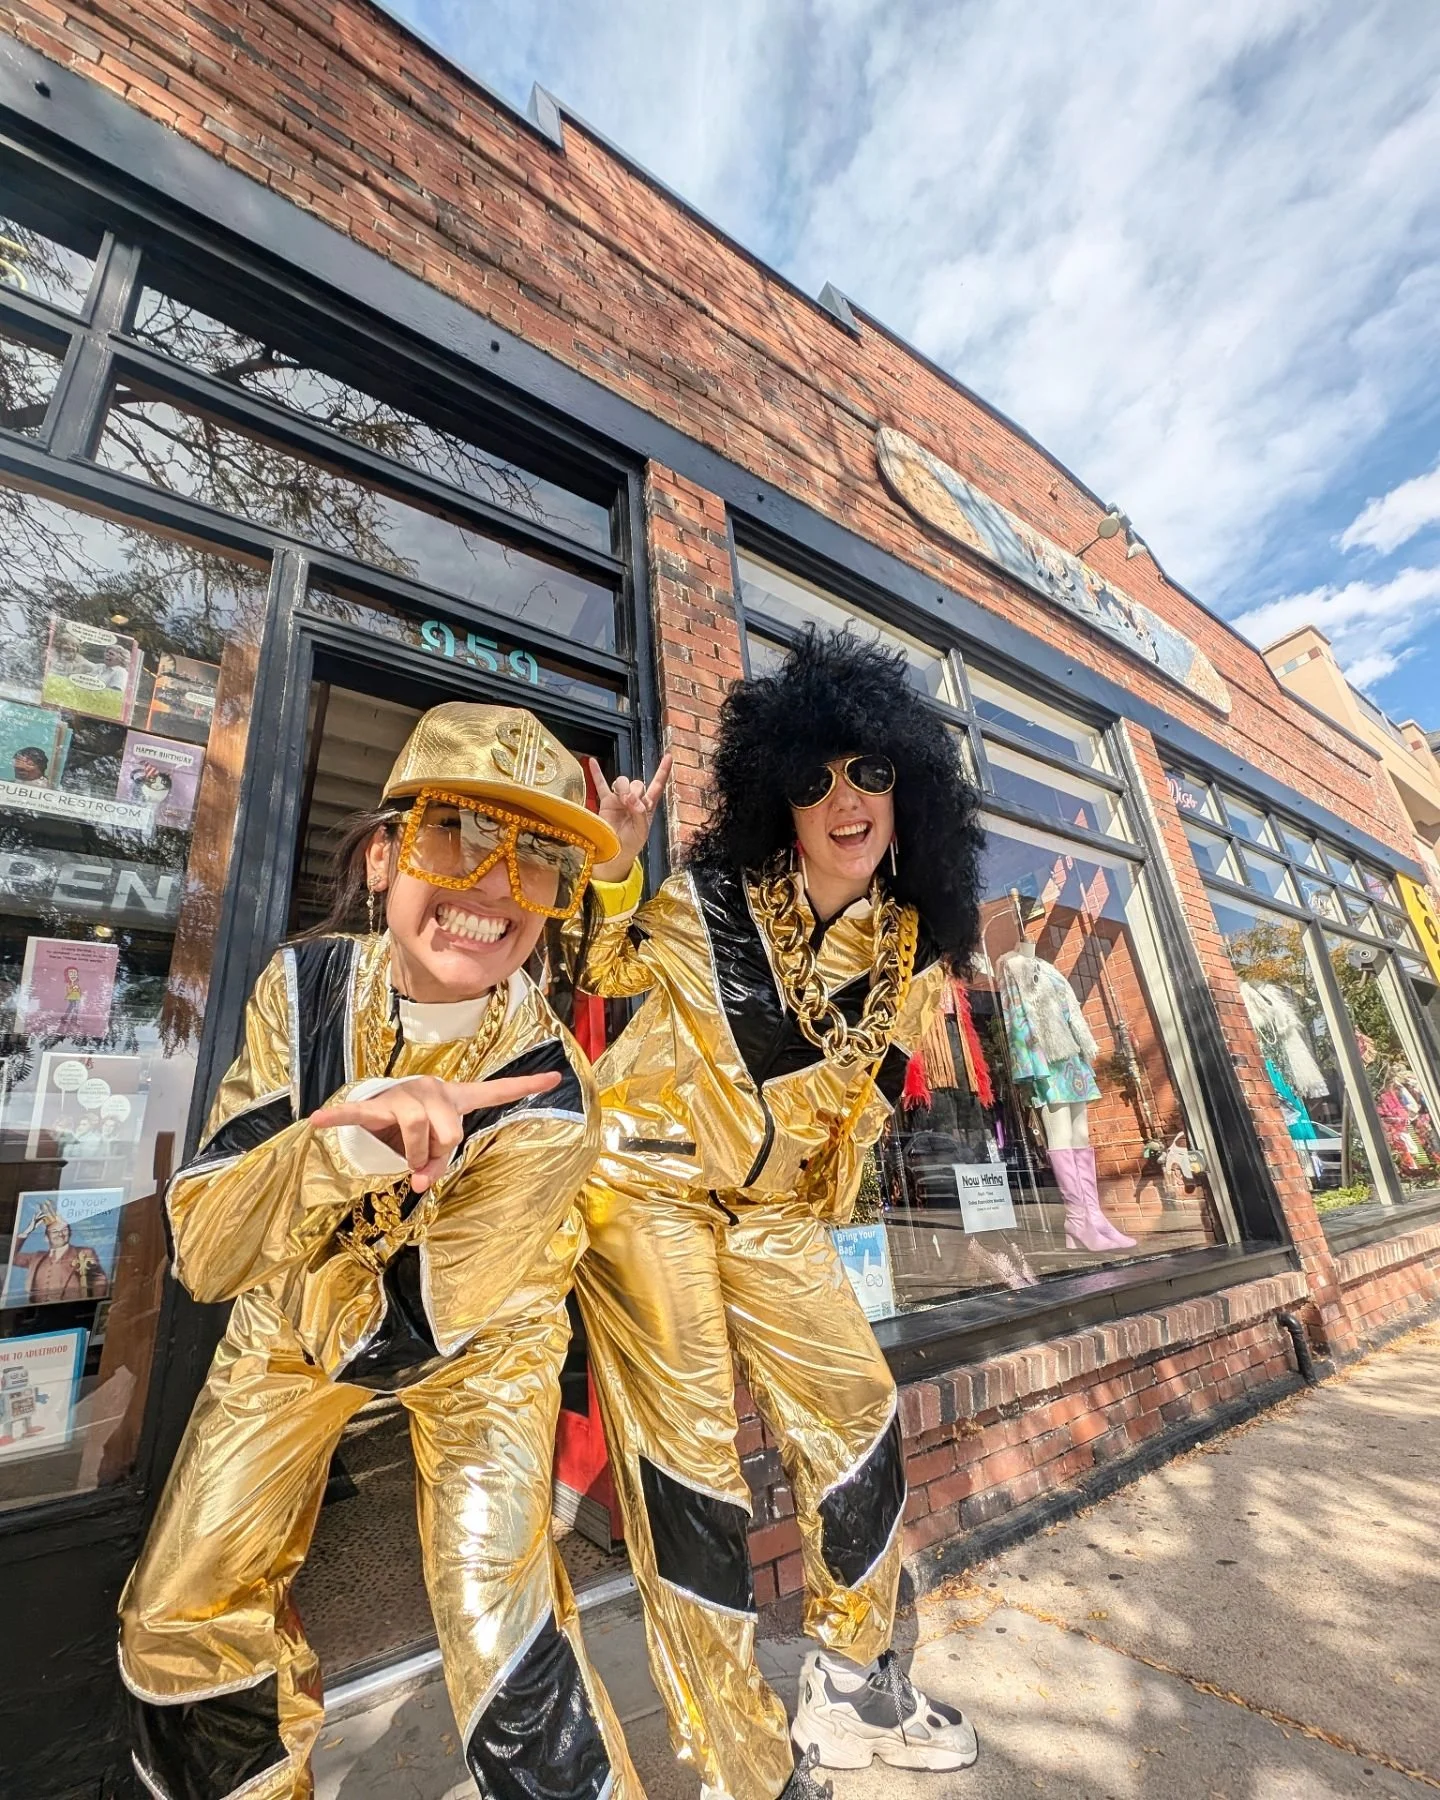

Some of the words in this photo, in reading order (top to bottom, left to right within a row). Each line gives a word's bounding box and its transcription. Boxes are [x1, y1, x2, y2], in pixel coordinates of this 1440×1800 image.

[421, 620, 538, 685] 959
[135, 746, 157, 757] HAPPY
[159, 751, 192, 764] BIRTHDAY
[0, 784, 54, 803] PUBLIC
[58, 795, 142, 819] RESTROOM
[0, 852, 174, 914] PEN
[962, 1174, 980, 1187] Now
[980, 1172, 1004, 1187] Hiring
[81, 1198, 107, 1208] YOUR
[67, 1207, 113, 1219] BIRTHDAY
[837, 1230, 859, 1243] Bring
[859, 1229, 876, 1240] Your
[838, 1243, 857, 1257] Bag!
[13, 1351, 23, 1361] TO
[25, 1344, 68, 1358] ADULTHOOD
